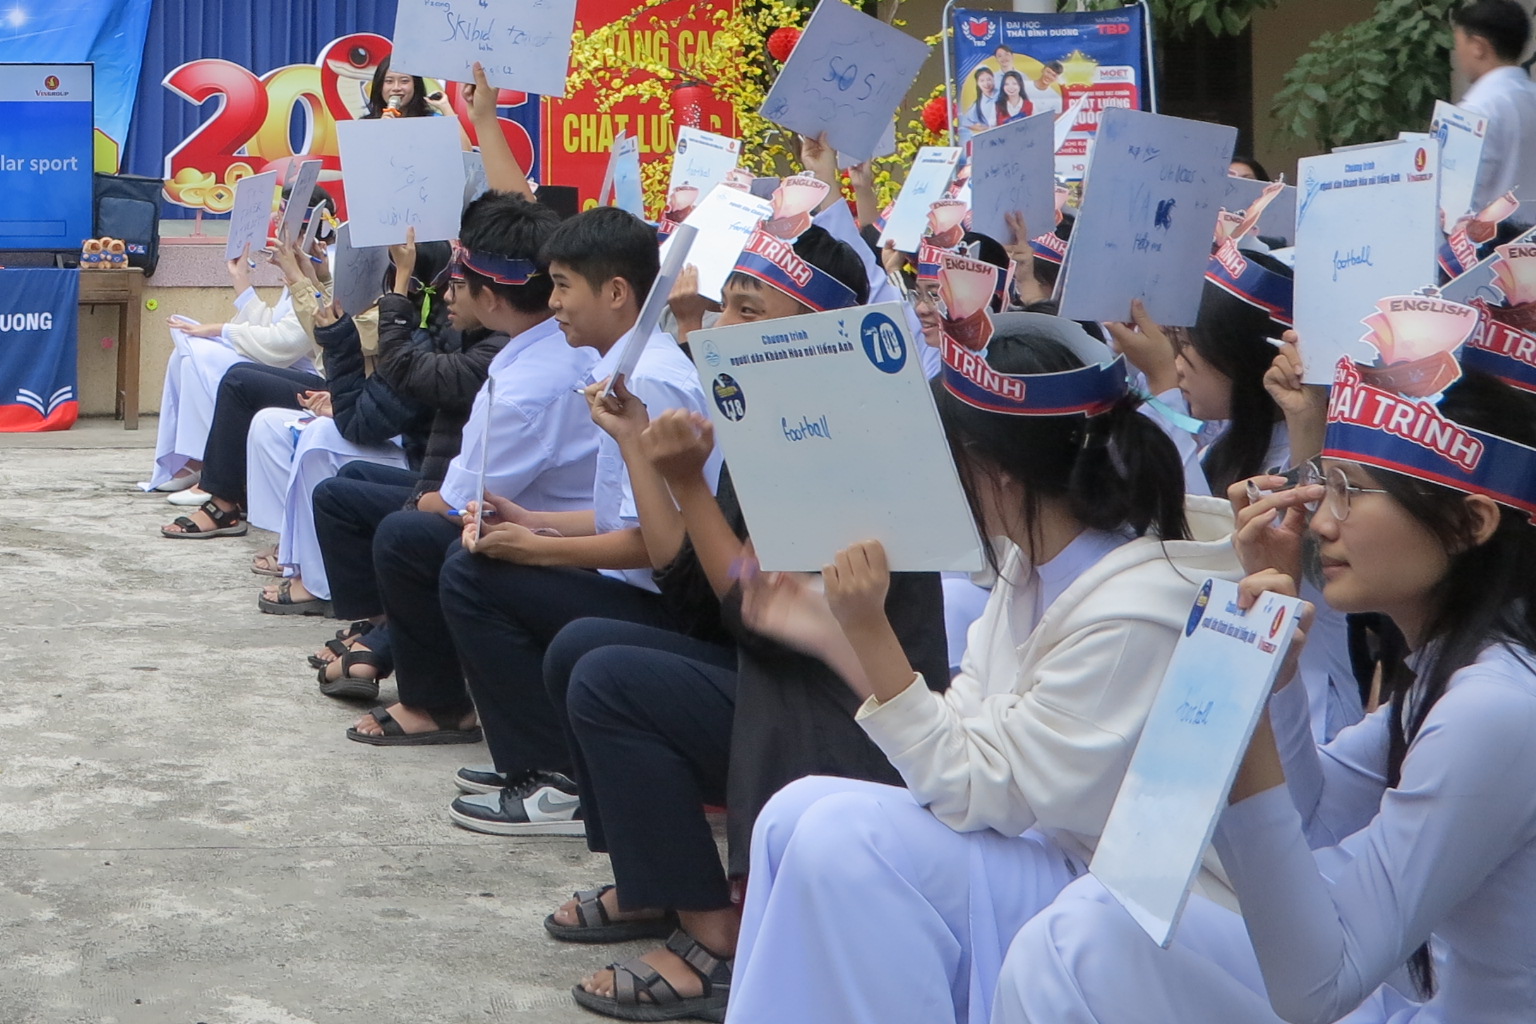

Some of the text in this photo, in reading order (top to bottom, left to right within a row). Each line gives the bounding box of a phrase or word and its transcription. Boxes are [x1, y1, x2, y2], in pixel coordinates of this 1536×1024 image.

[1096, 24, 1131, 35] TBD
[1100, 69, 1128, 77] MOET
[29, 157, 78, 175] sport
[786, 178, 827, 191] ENGLISH
[757, 236, 810, 284] TRÌNH
[945, 258, 992, 275] ENGLISH
[1390, 299, 1471, 318] ENGLISH
[952, 345, 1021, 401] TRÌNH
[1372, 395, 1480, 467] TRÌNH
